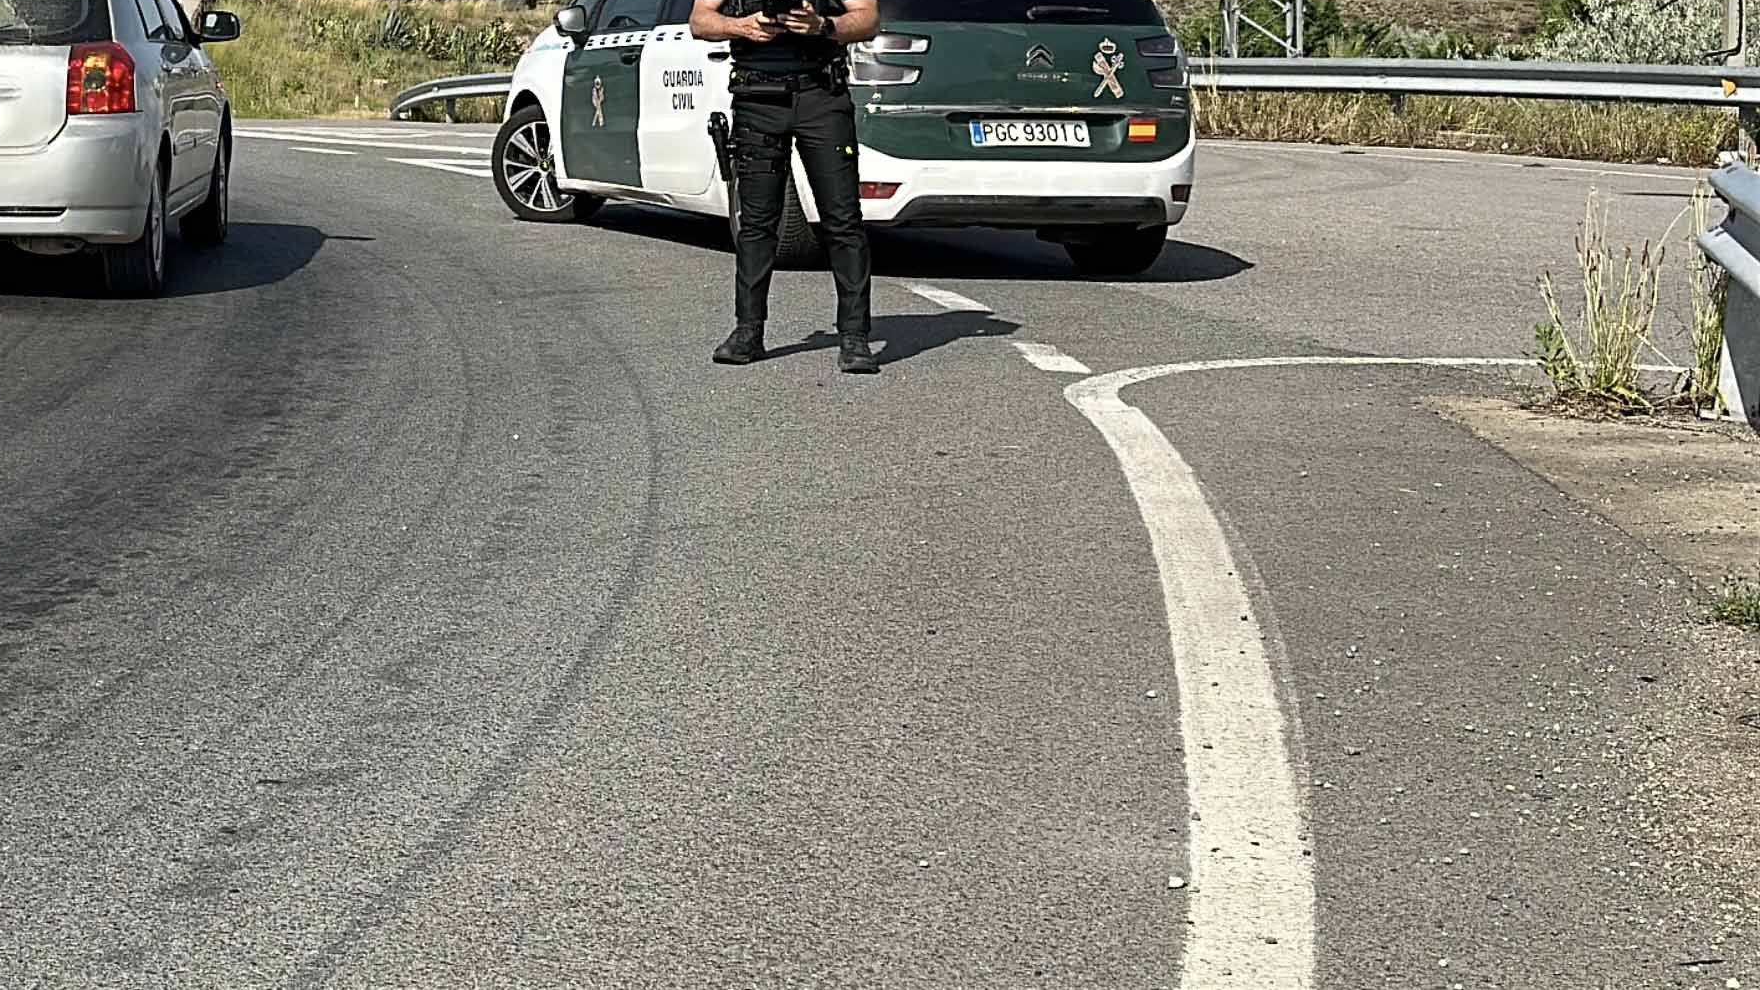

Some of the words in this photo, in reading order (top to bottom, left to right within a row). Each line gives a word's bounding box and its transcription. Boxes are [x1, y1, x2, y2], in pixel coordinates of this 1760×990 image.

[663, 70, 703, 87] GUARDIA
[672, 93, 695, 110] CIVIL
[983, 123, 1019, 142] PGC
[1024, 123, 1068, 142] 9301
[1074, 123, 1085, 142] C
